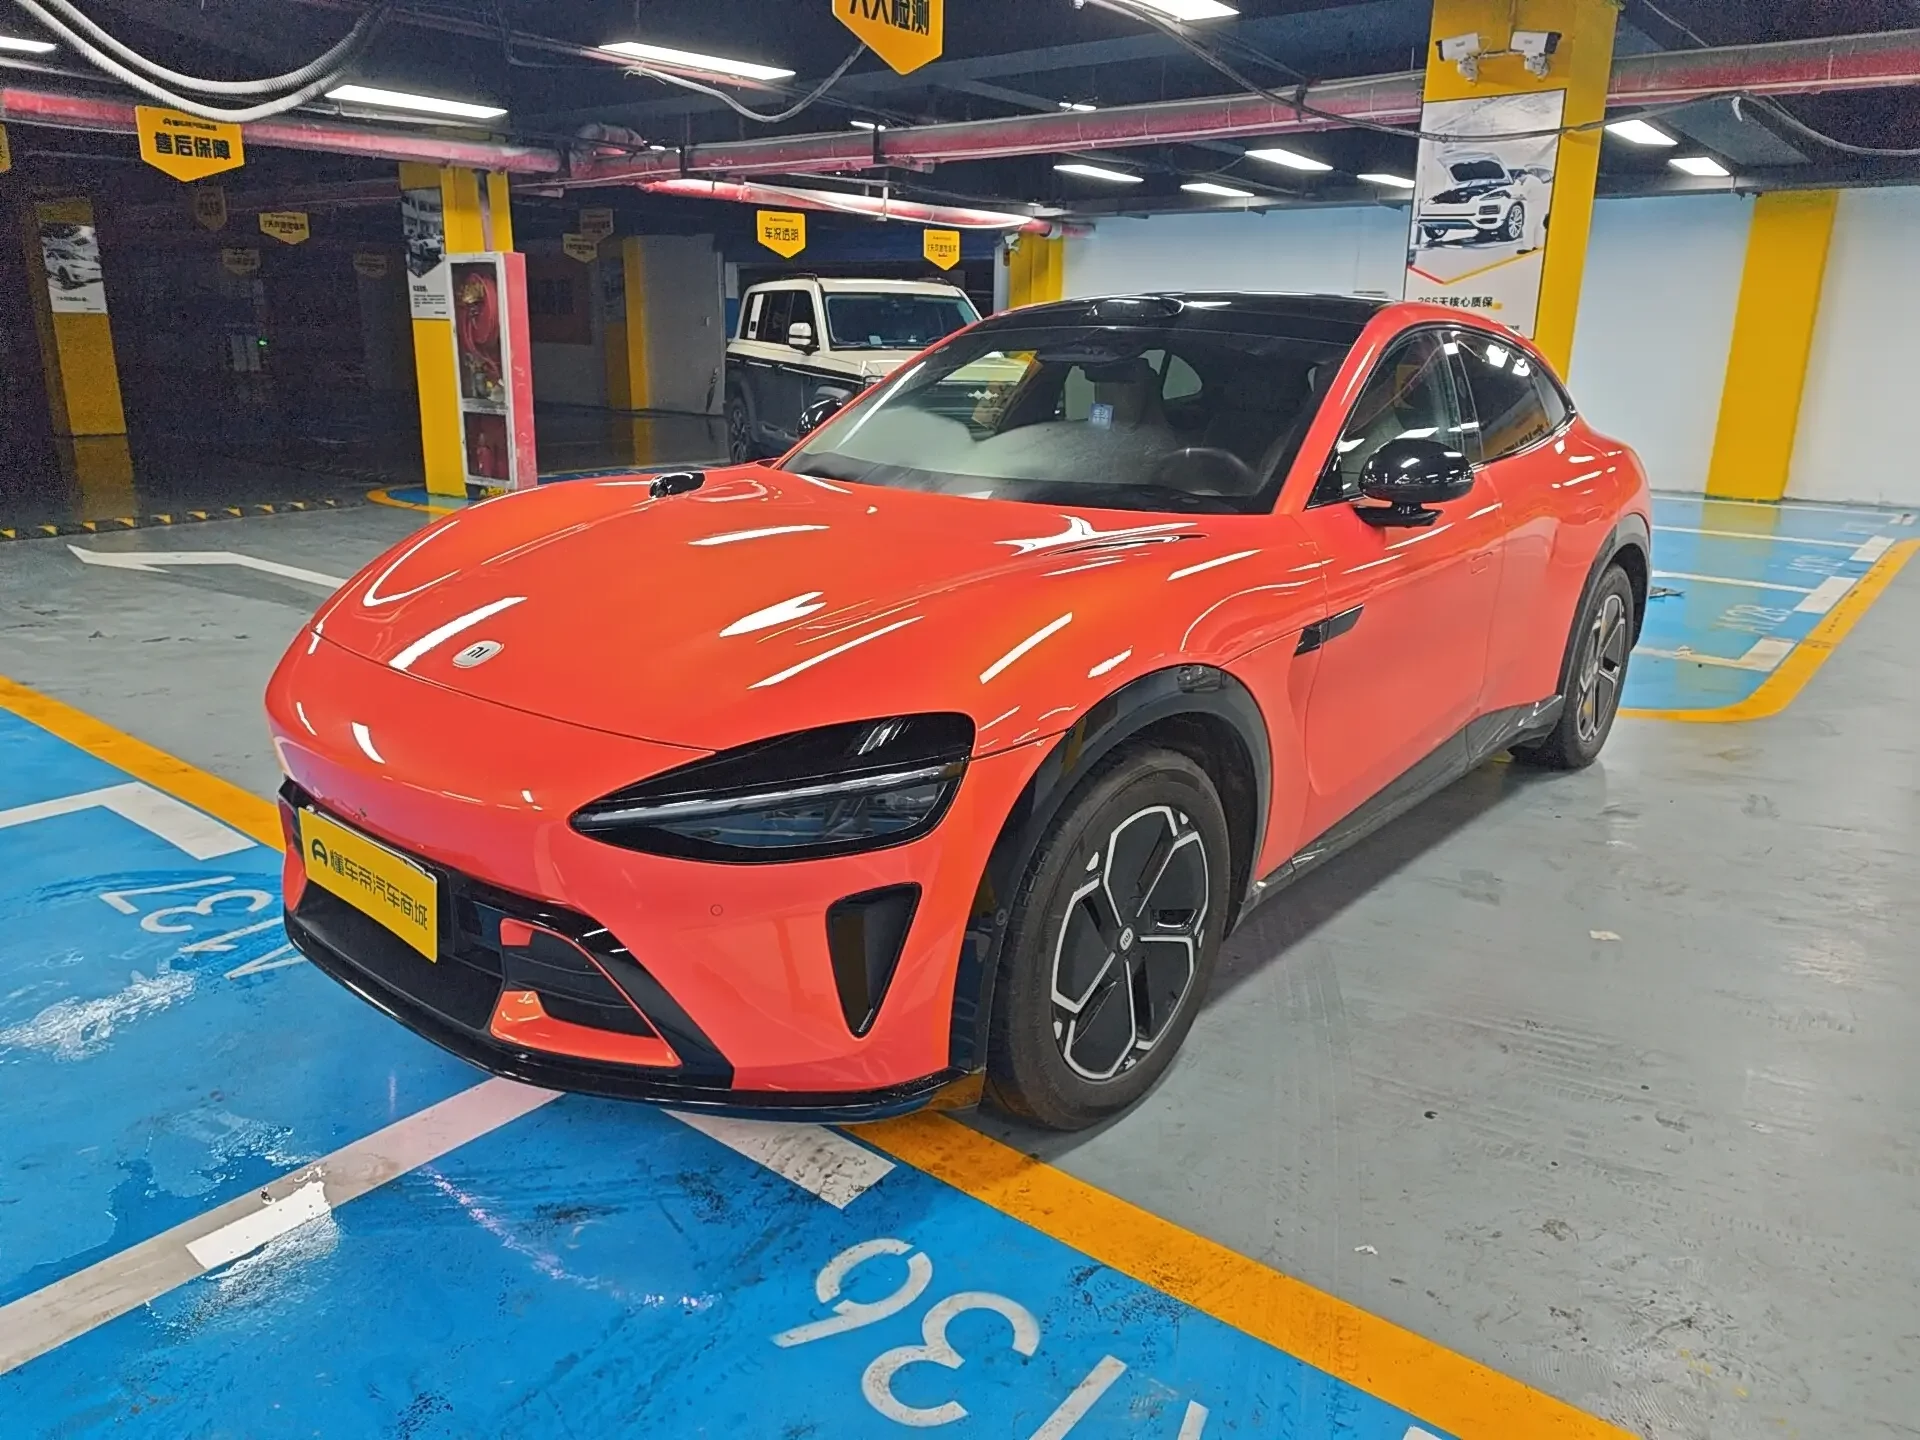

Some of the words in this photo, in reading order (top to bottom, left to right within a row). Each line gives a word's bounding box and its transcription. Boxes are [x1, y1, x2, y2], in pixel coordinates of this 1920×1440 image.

[154, 131, 231, 160] 售后保障
[765, 226, 799, 241] 车况透明
[330, 849, 428, 930] 懂车帝汽车商城
[771, 1237, 1210, 1440] 136
